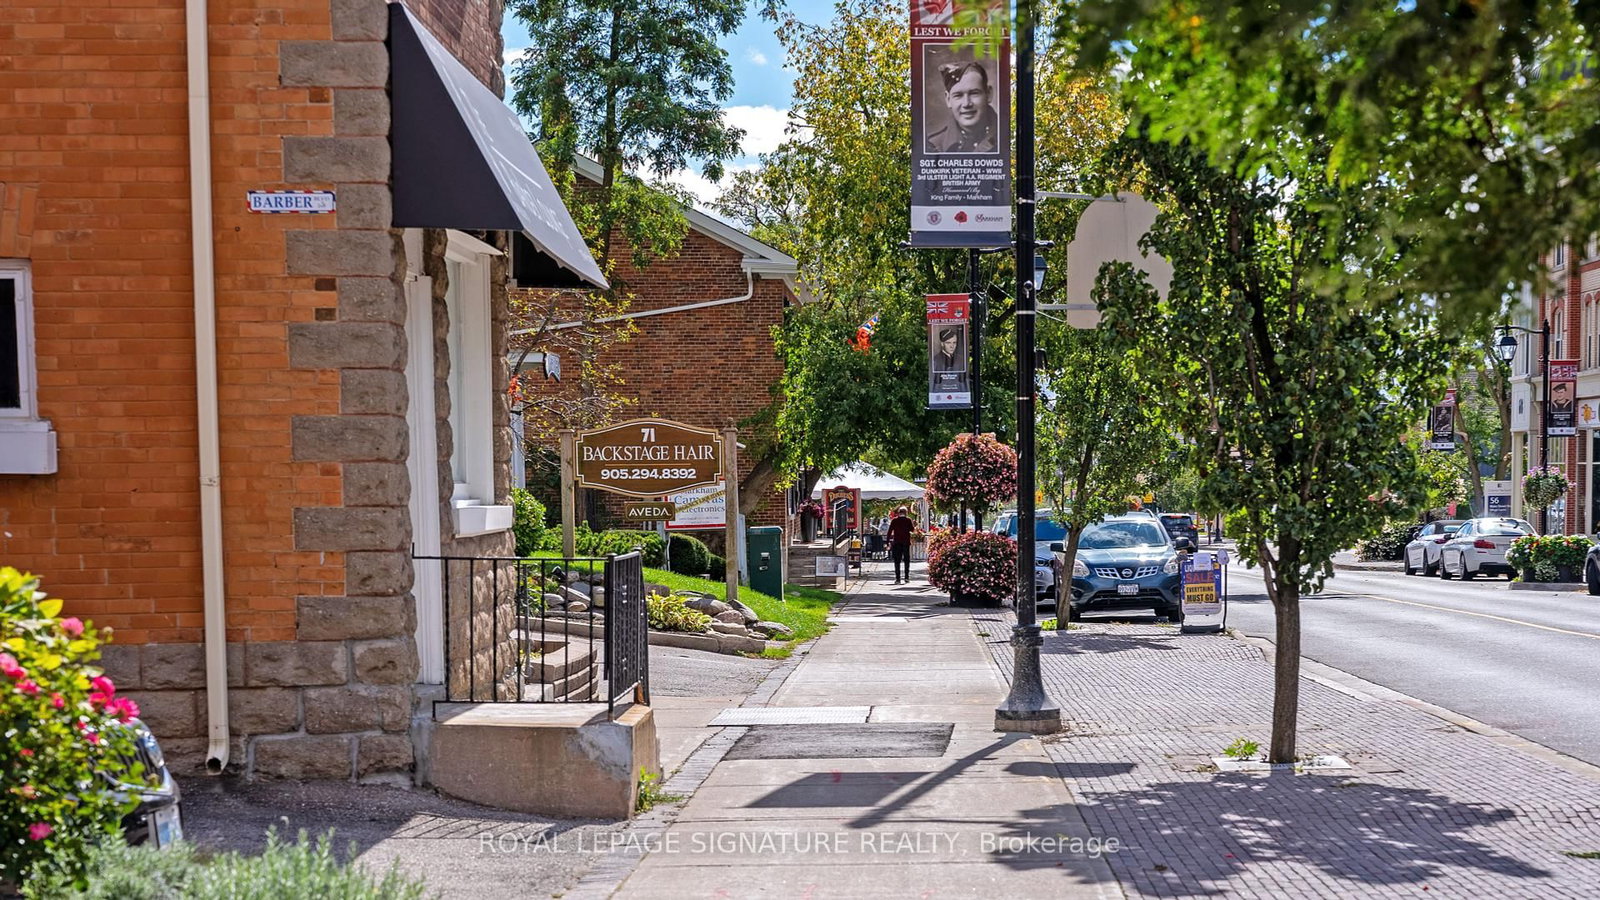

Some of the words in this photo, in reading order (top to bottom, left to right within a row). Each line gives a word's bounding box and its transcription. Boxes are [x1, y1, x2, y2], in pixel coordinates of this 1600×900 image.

[914, 27, 941, 36] LEST
[943, 27, 961, 36] WE
[964, 27, 1007, 36] FORGT
[919, 159, 936, 167] SGT.
[937, 159, 973, 167] CHARLES
[974, 159, 1004, 167] DOWDS
[253, 196, 313, 208] BARBER
[641, 427, 656, 443] 71
[583, 445, 670, 461] BACKSTAGE
[674, 445, 715, 460] HAIR
[600, 468, 697, 480] 905.294.8392
[1490, 496, 1500, 504] 56
[628, 507, 671, 517] AVEDA
[1185, 571, 1214, 582] SALE
[1186, 585, 1214, 593] EVERYTHING
[1186, 594, 1204, 602] MUST
[1204, 593, 1214, 601] GO
